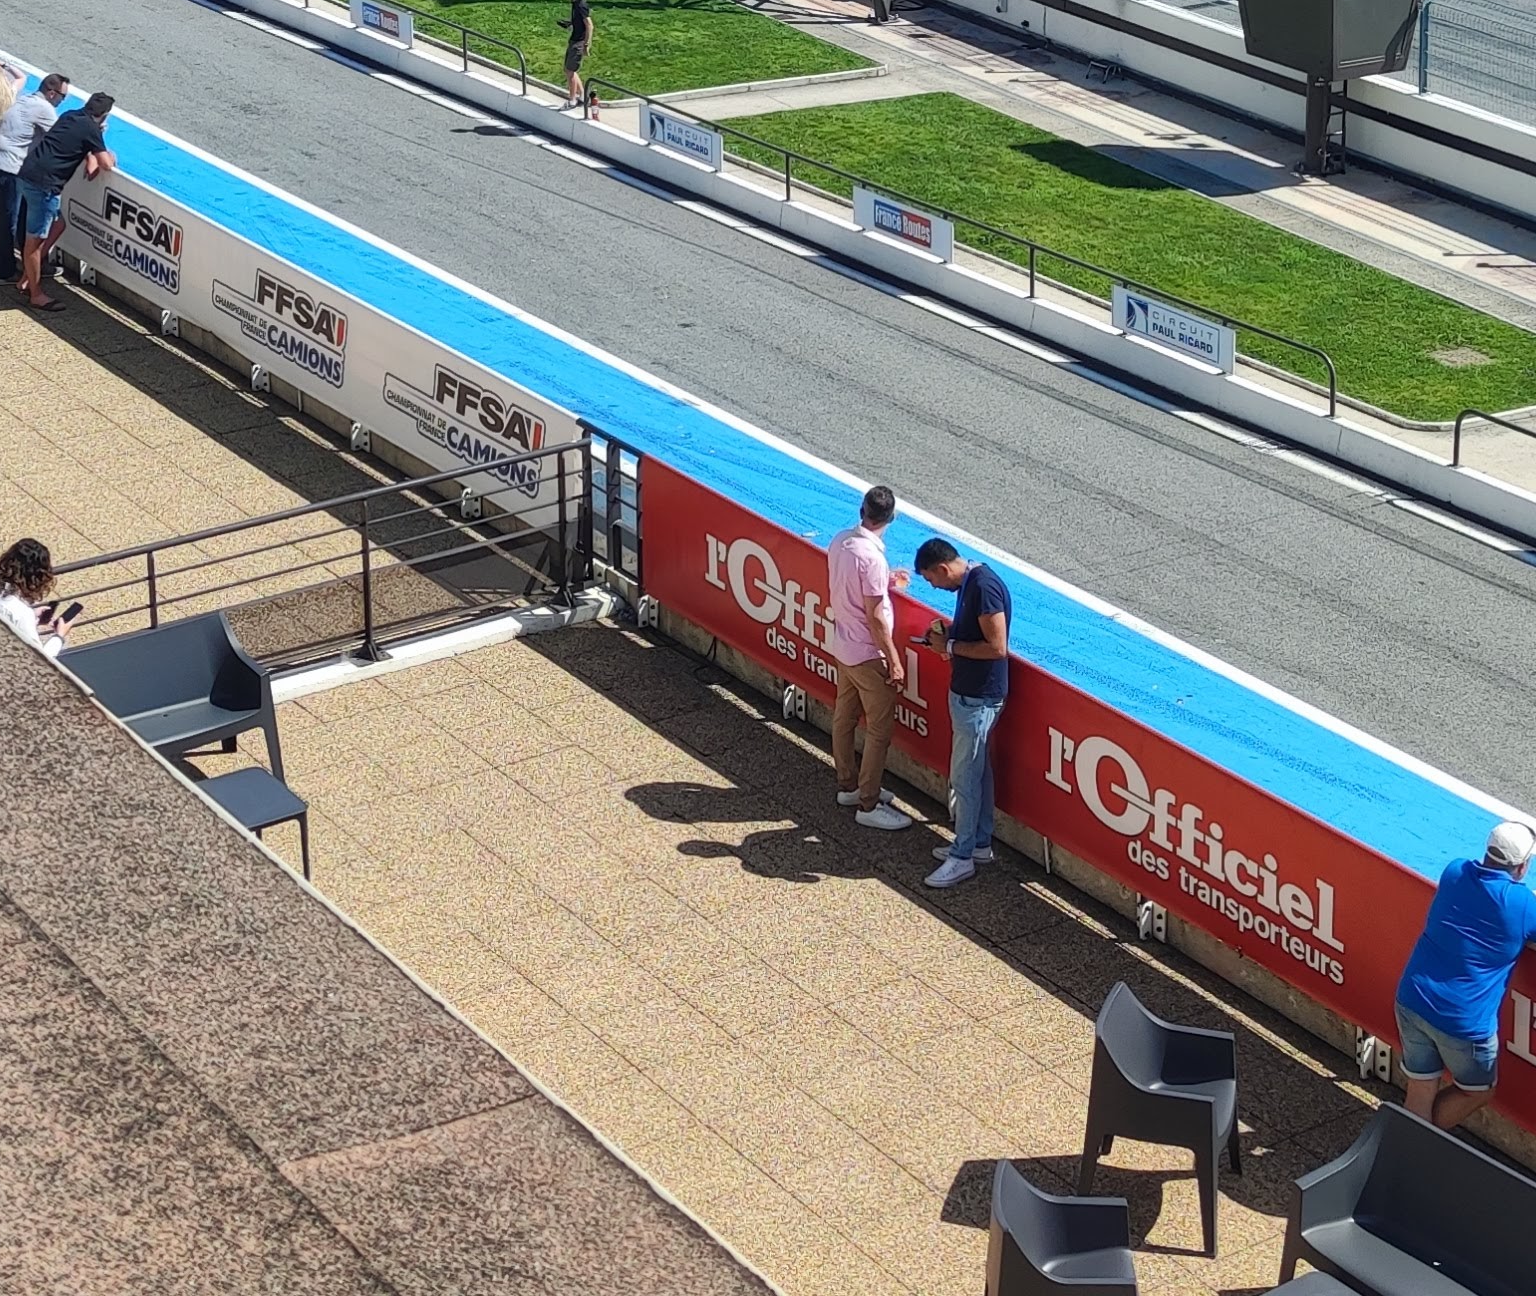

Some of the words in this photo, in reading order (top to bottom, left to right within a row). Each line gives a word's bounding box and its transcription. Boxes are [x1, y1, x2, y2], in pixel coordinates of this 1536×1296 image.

[667, 123, 708, 145] CIRCUIT
[667, 132, 683, 146] PAUL
[685, 139, 709, 156] RICARD
[105, 193, 173, 255] FFSA
[114, 239, 178, 290] CAMIONS
[215, 294, 259, 324] CHAMPIONNAT
[259, 316, 268, 329] DE
[257, 274, 336, 345] FFSA
[1152, 311, 1214, 341] CIRCUIT
[242, 321, 267, 341] FRANCE
[1152, 322, 1176, 340] PAUL
[1178, 332, 1213, 354] RICARD
[267, 324, 341, 383] CAMIONS
[386, 389, 436, 423] CHAMPIONNAT
[437, 416, 447, 431] DE
[418, 419, 446, 442] FRANCE
[435, 370, 531, 451] FFSA
[446, 426, 538, 492] CAMIONS
[766, 626, 798, 661] des
[1045, 726, 1345, 954] l'Officiel
[1127, 839, 1171, 881] des
[1178, 866, 1344, 985] transporteurs
